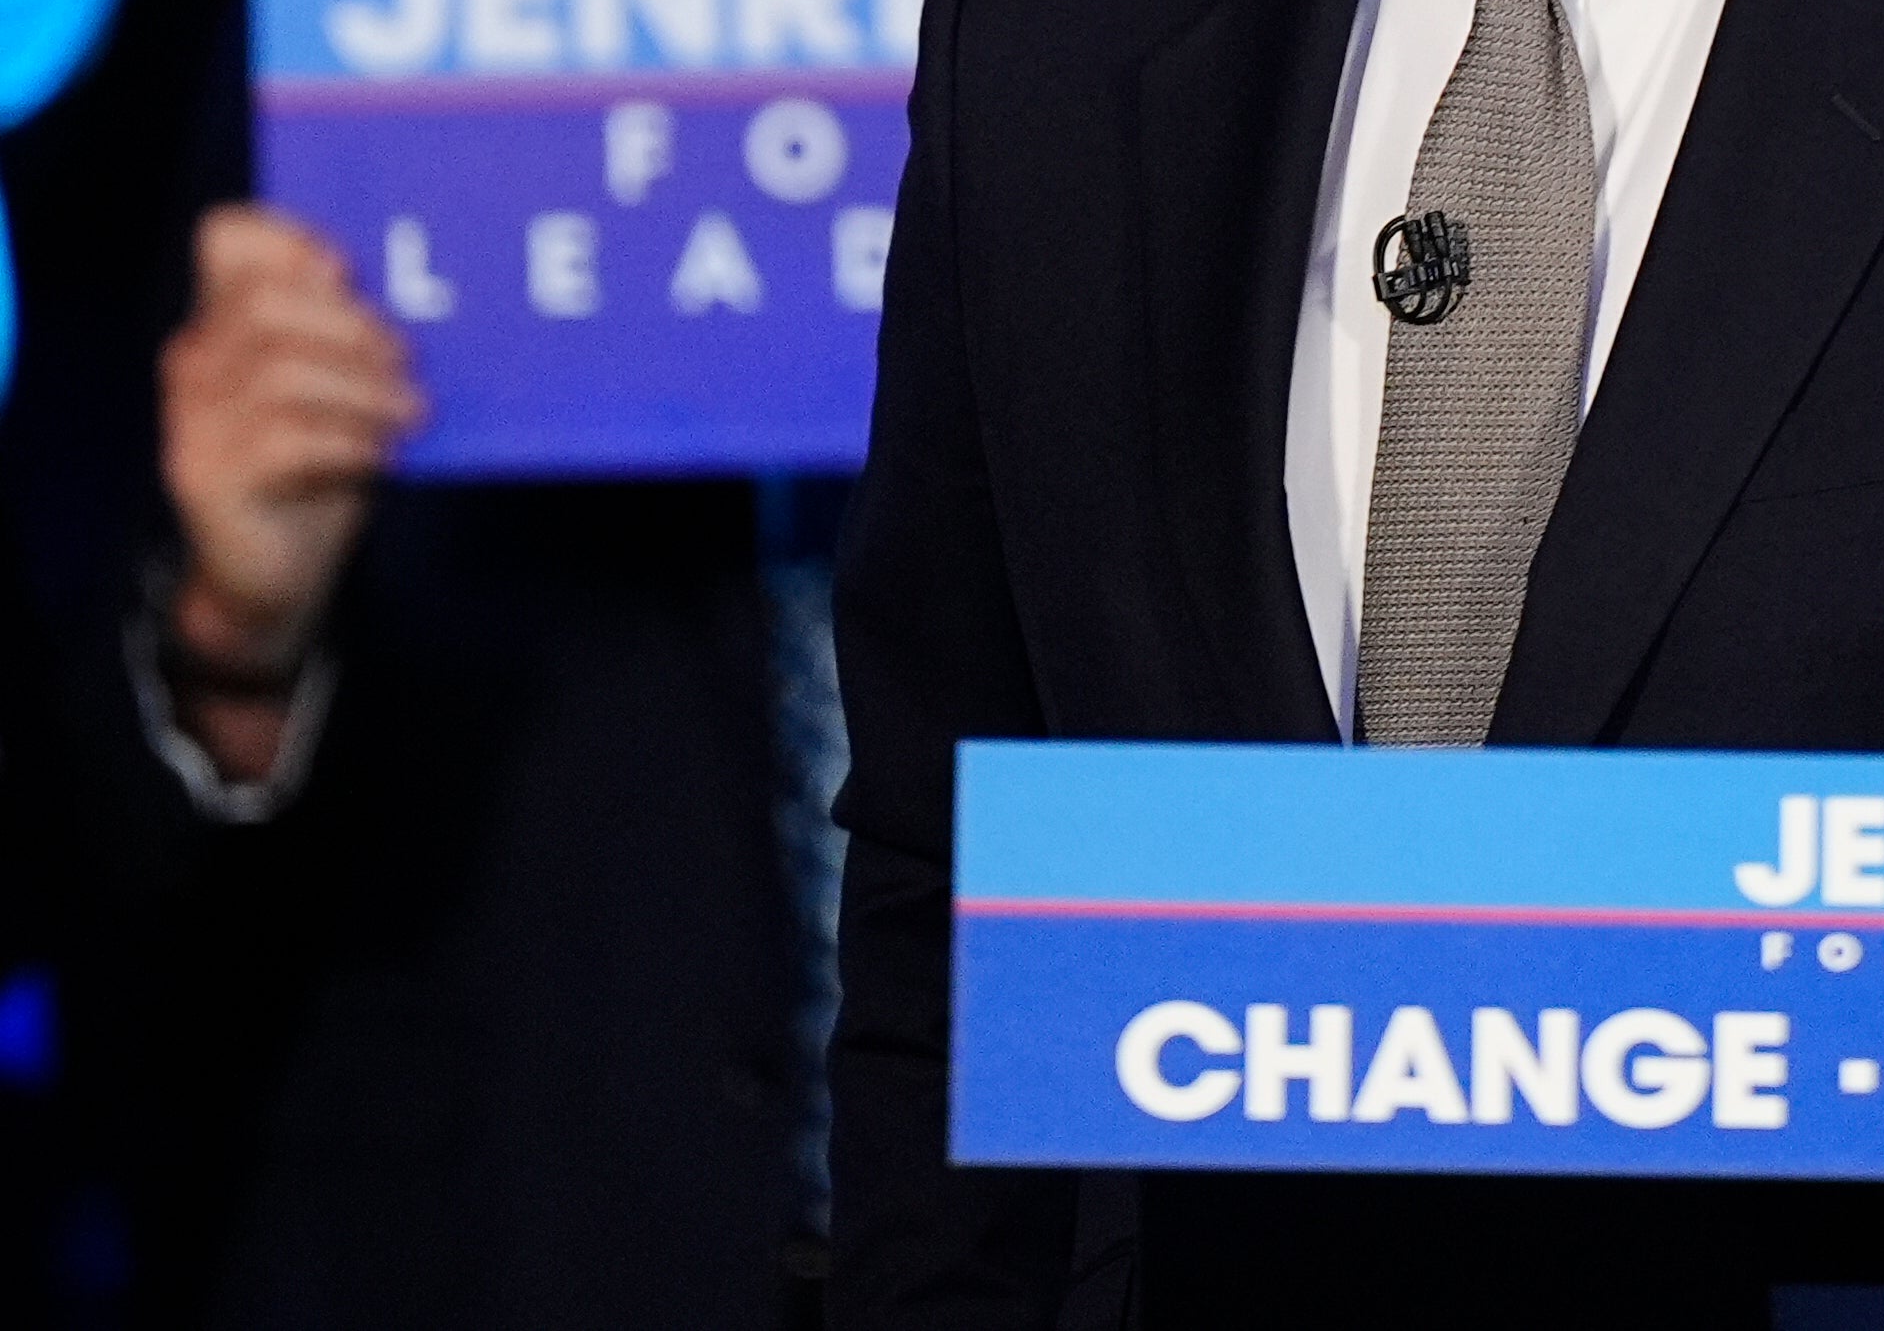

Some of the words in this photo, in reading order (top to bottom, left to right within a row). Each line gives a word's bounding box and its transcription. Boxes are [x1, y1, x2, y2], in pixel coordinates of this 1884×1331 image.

[606, 99, 848, 206] FO
[386, 205, 895, 321] LEAD
[1115, 1000, 1790, 1130] CHANGE
